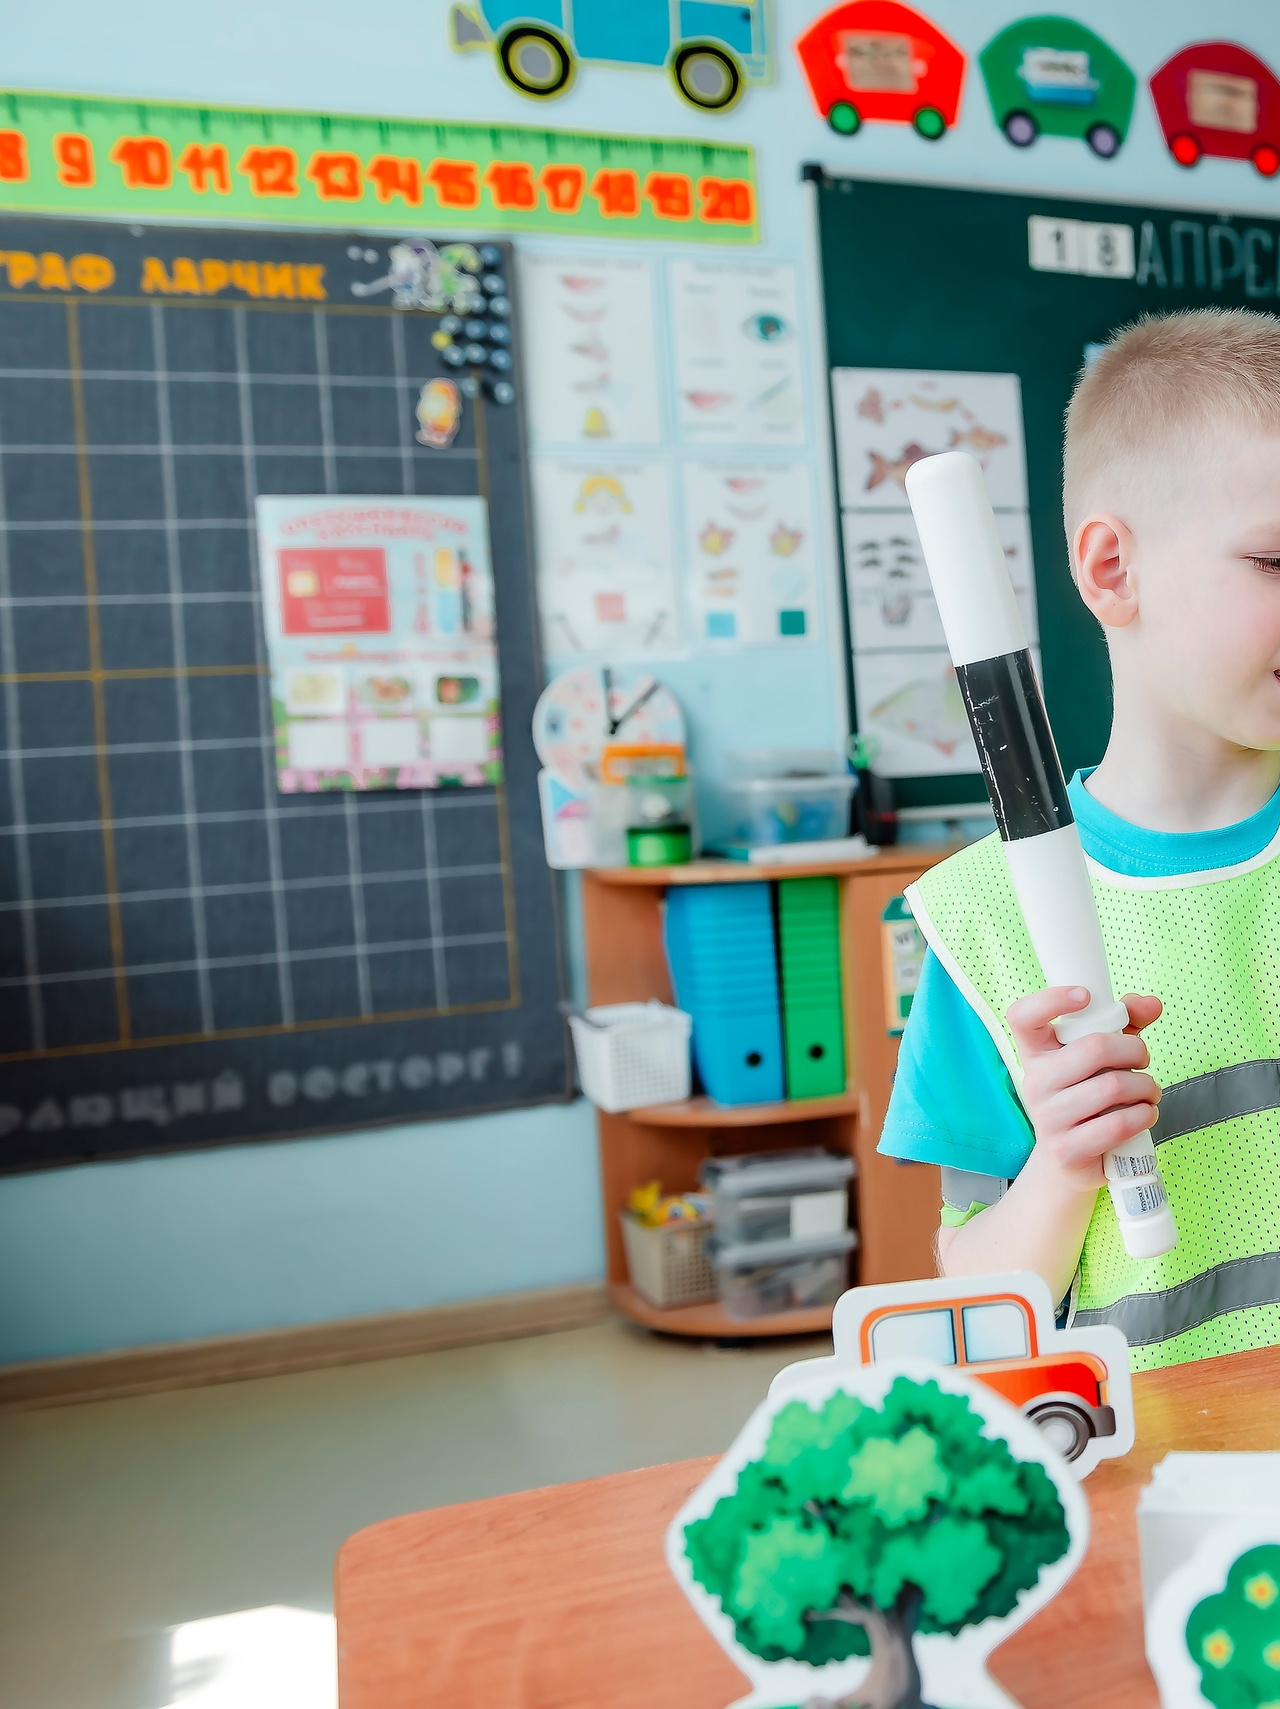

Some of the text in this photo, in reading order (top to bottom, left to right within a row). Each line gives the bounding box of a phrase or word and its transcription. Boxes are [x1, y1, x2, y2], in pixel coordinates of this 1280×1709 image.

[0, 131, 755, 224] 8 9 10 11 12 13 14 15 16 17 18 19 20
[0, 250, 327, 299] РАФ ЛАРЧИК
